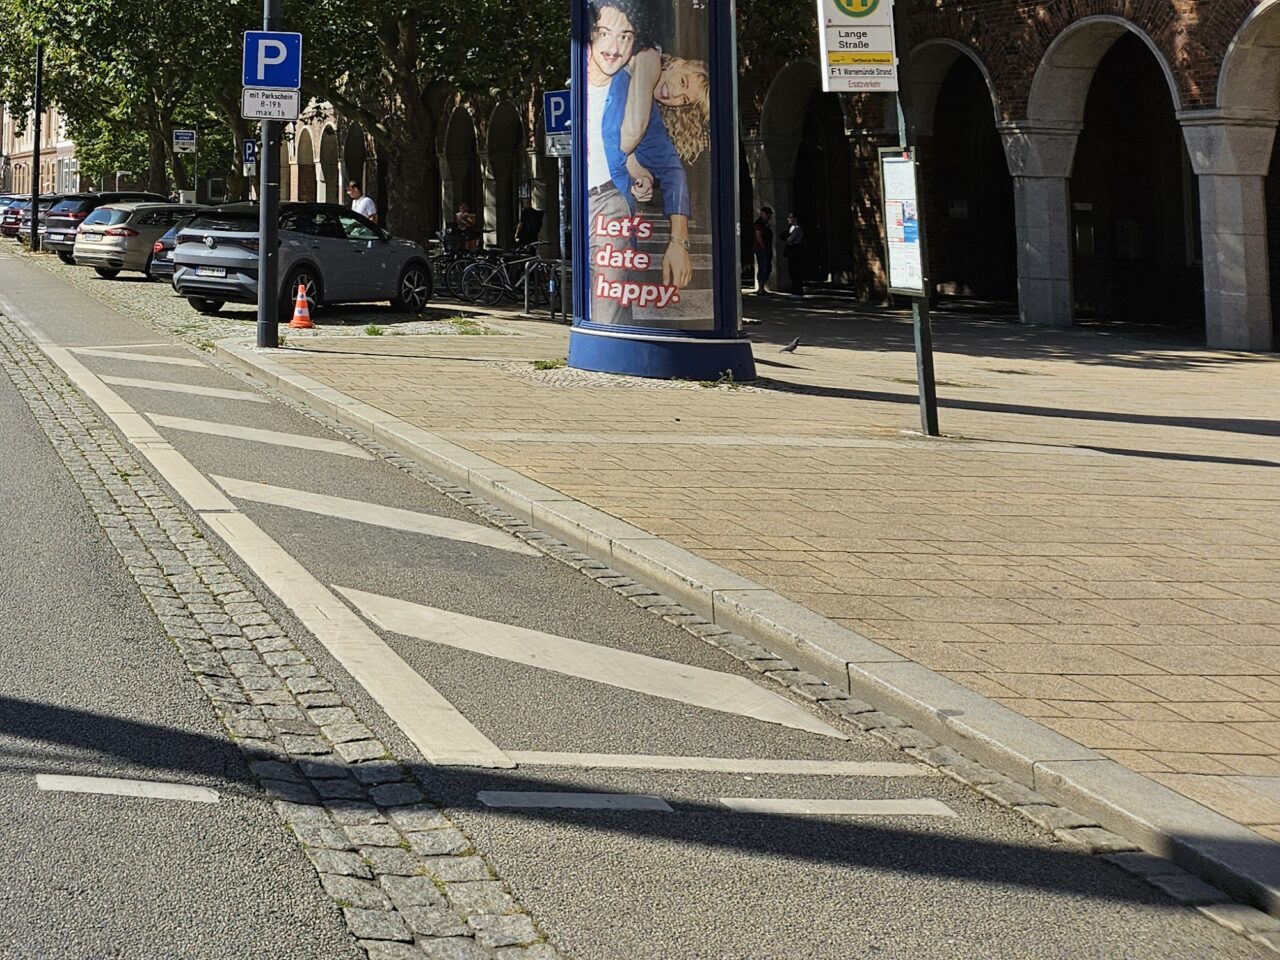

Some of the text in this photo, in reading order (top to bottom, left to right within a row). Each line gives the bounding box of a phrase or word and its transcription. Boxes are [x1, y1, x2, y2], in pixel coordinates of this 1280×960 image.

[838, 30, 868, 40] Lange
[838, 40, 870, 49] Straße
[256, 39, 287, 80] P
[831, 67, 892, 76] F1 Warnemünde Strand
[847, 80, 881, 88] Ersatzverkehr
[261, 92, 293, 100] Parkschein
[550, 96, 565, 128] P
[596, 214, 652, 238] Let's
[596, 243, 649, 268] date
[596, 274, 680, 307] happy.
